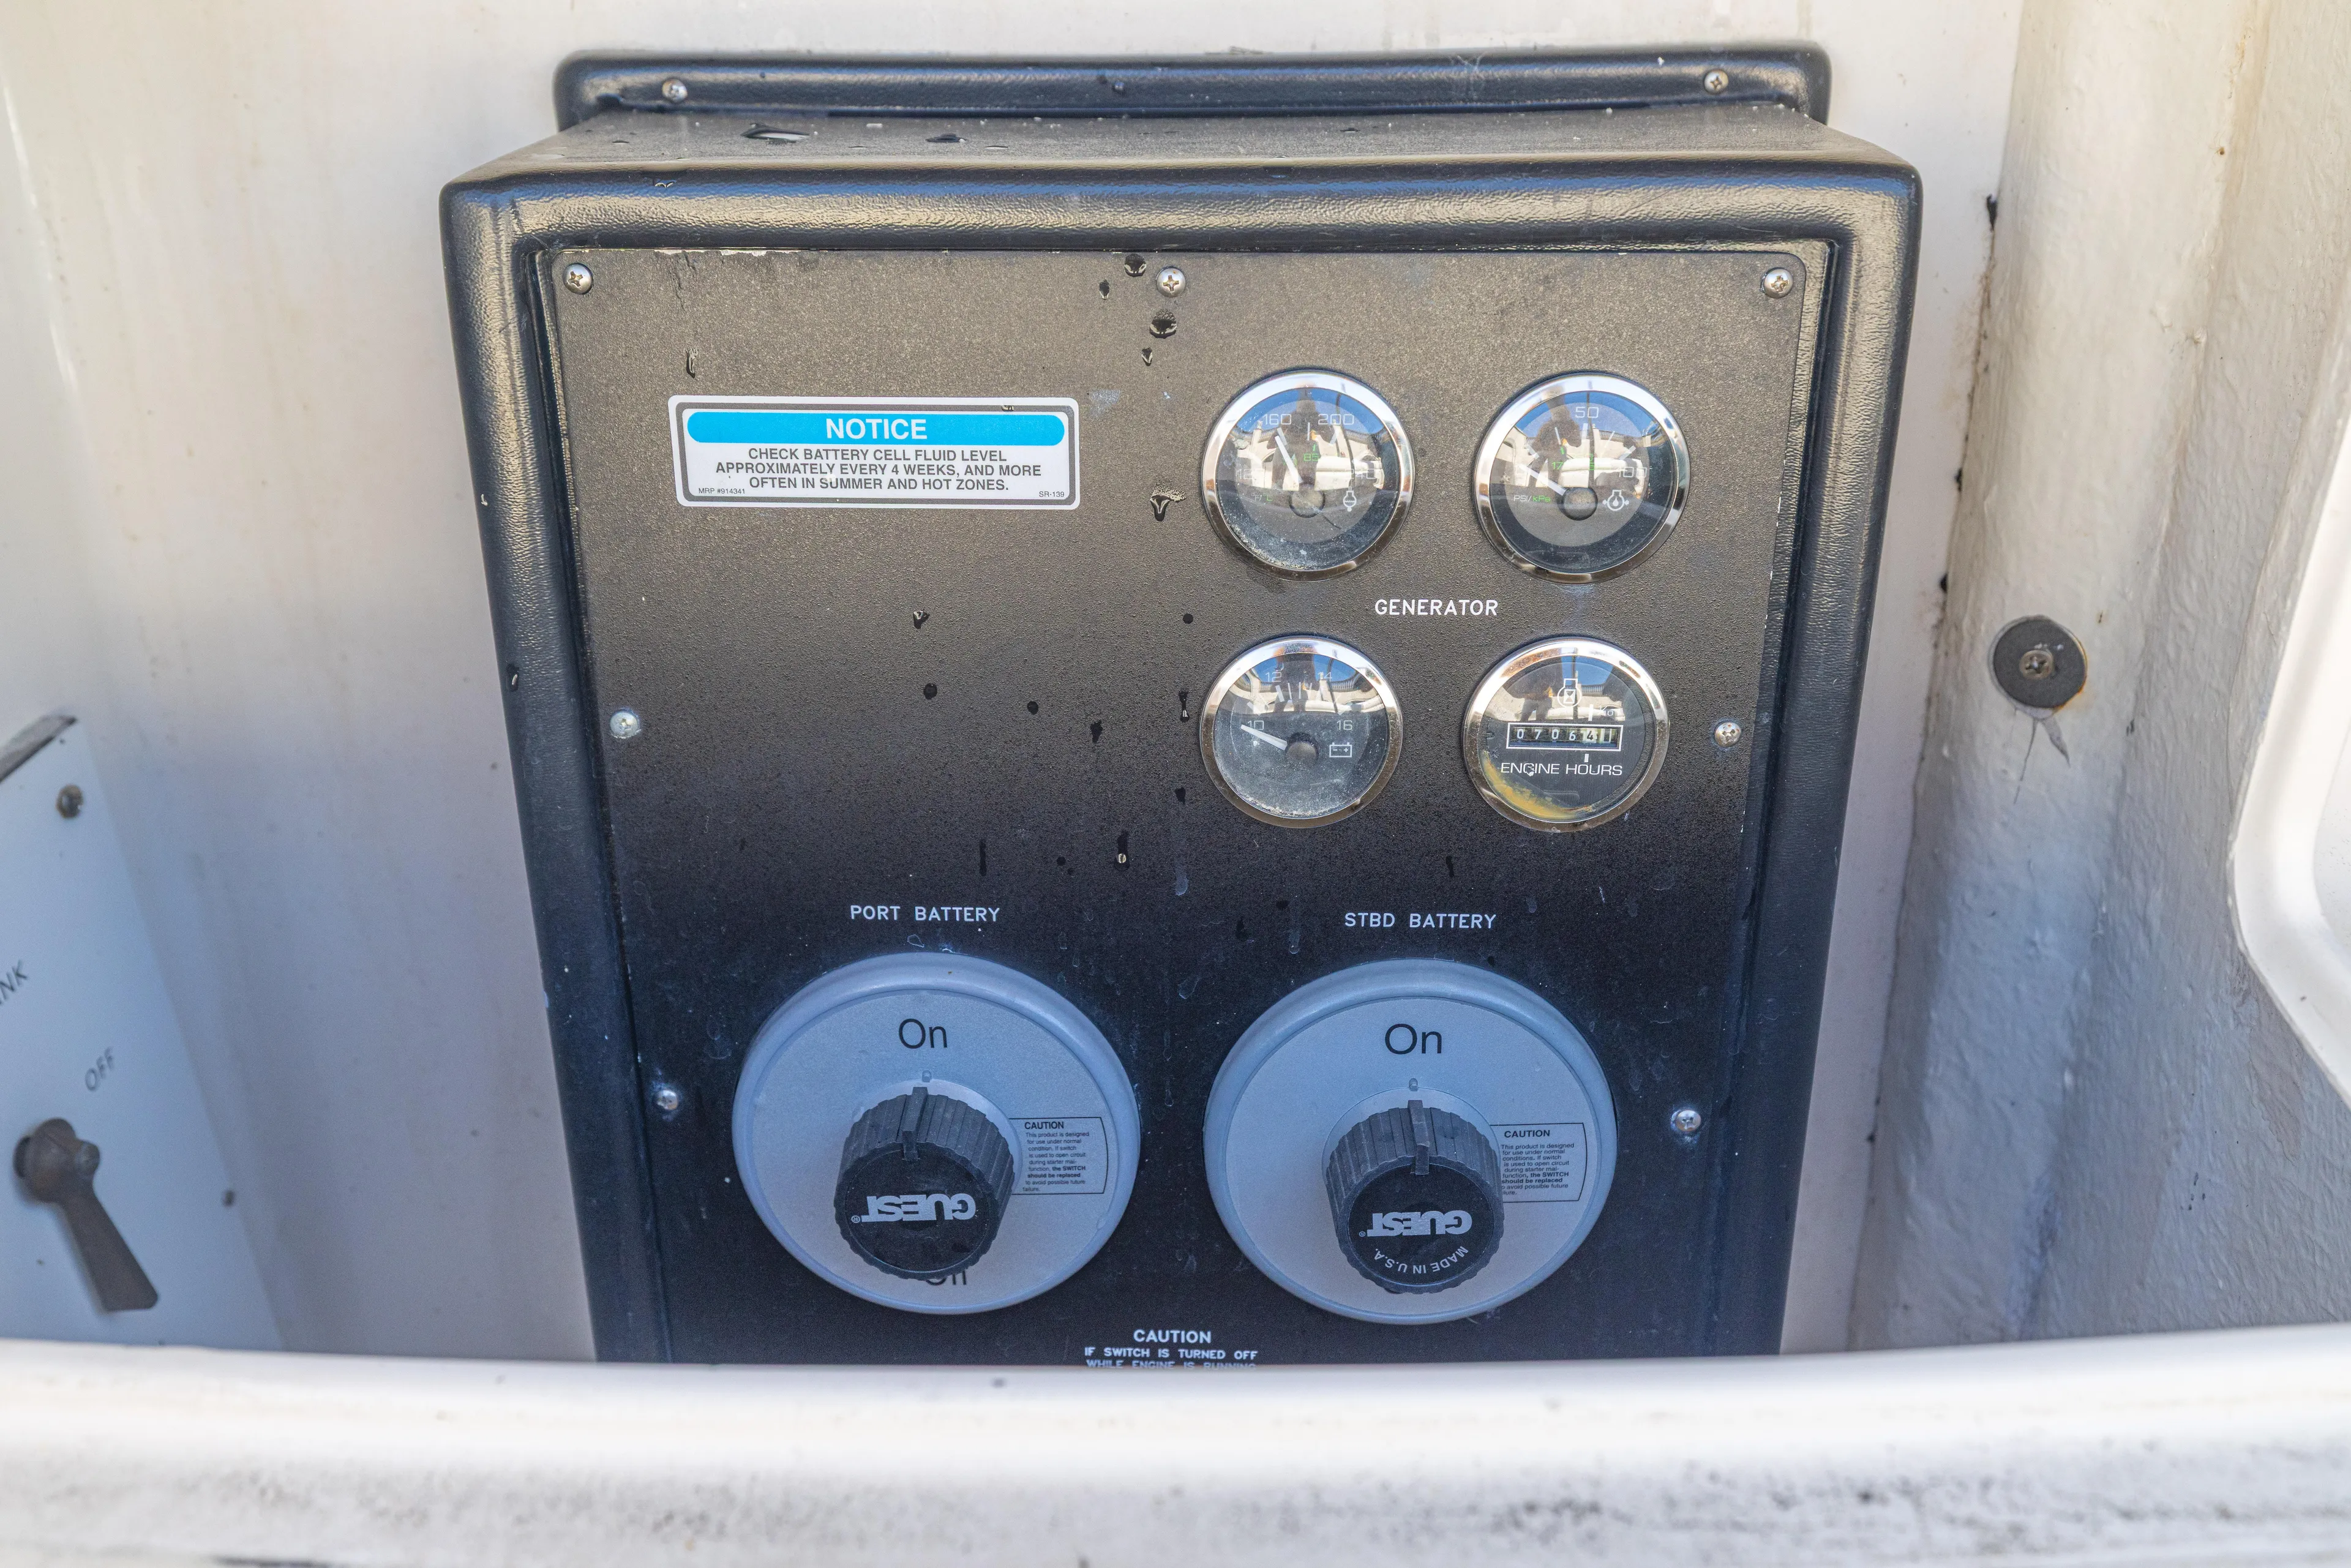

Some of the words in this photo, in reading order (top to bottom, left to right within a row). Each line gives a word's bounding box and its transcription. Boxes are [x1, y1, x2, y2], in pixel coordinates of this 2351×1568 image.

[1262, 413, 1292, 426] 160
[1318, 413, 1355, 426] 200
[1575, 406, 1599, 419] 50
[826, 418, 928, 440] NOTICE
[748, 448, 800, 460] CHECK
[803, 448, 869, 460] BATTERY
[873, 449, 911, 461] CELL
[915, 449, 957, 462] FLUID
[961, 450, 1007, 462] LEVEL
[716, 462, 835, 475] APPROXIMATELY
[839, 463, 887, 475] EVERY
[891, 463, 899, 475] 4
[903, 463, 960, 478] WEEKS,
[964, 464, 995, 476] AND
[999, 464, 1041, 476] MORE
[749, 476, 797, 489] OFTEN
[801, 477, 816, 489] IN
[819, 478, 883, 490] SUMMER
[887, 478, 918, 490] AND
[922, 478, 952, 490] HOT
[955, 478, 1009, 490] ZONES.
[1374, 599, 1499, 616] GENERATOR
[1265, 672, 1283, 683] 12
[1317, 672, 1333, 682] 14
[1247, 720, 1264, 731] 10
[1337, 720, 1353, 730] 16
[1501, 762, 1561, 776] ENGINE
[1565, 764, 1623, 776] HOURS
[850, 904, 901, 921] PORT
[915, 906, 1000, 922] BATTERY
[1344, 912, 1395, 928] STBD
[1409, 913, 1496, 929] BATTERY
[0, 959, 28, 1005] NK
[898, 1018, 948, 1049] On
[1384, 1023, 1443, 1056] On
[84, 1046, 115, 1092] OFF
[1024, 1121, 1064, 1130] CAUTION
[1504, 1130, 1550, 1138] CAUTION
[1373, 1248, 1408, 1274] U.S.A.
[1430, 1246, 1469, 1272] MADE
[1412, 1264, 1427, 1274] IN
[1133, 1329, 1212, 1344] CAUTION
[1084, 1346, 1096, 1357] IF
[1103, 1347, 1150, 1358] SWITCH
[1158, 1348, 1170, 1358] IS
[1177, 1349, 1226, 1359] TURNED
[1233, 1350, 1259, 1360] OFF
[1086, 1359, 1124, 1369] WHILE
[1132, 1360, 1176, 1370] ENGINE
[1183, 1361, 1195, 1370] IS
